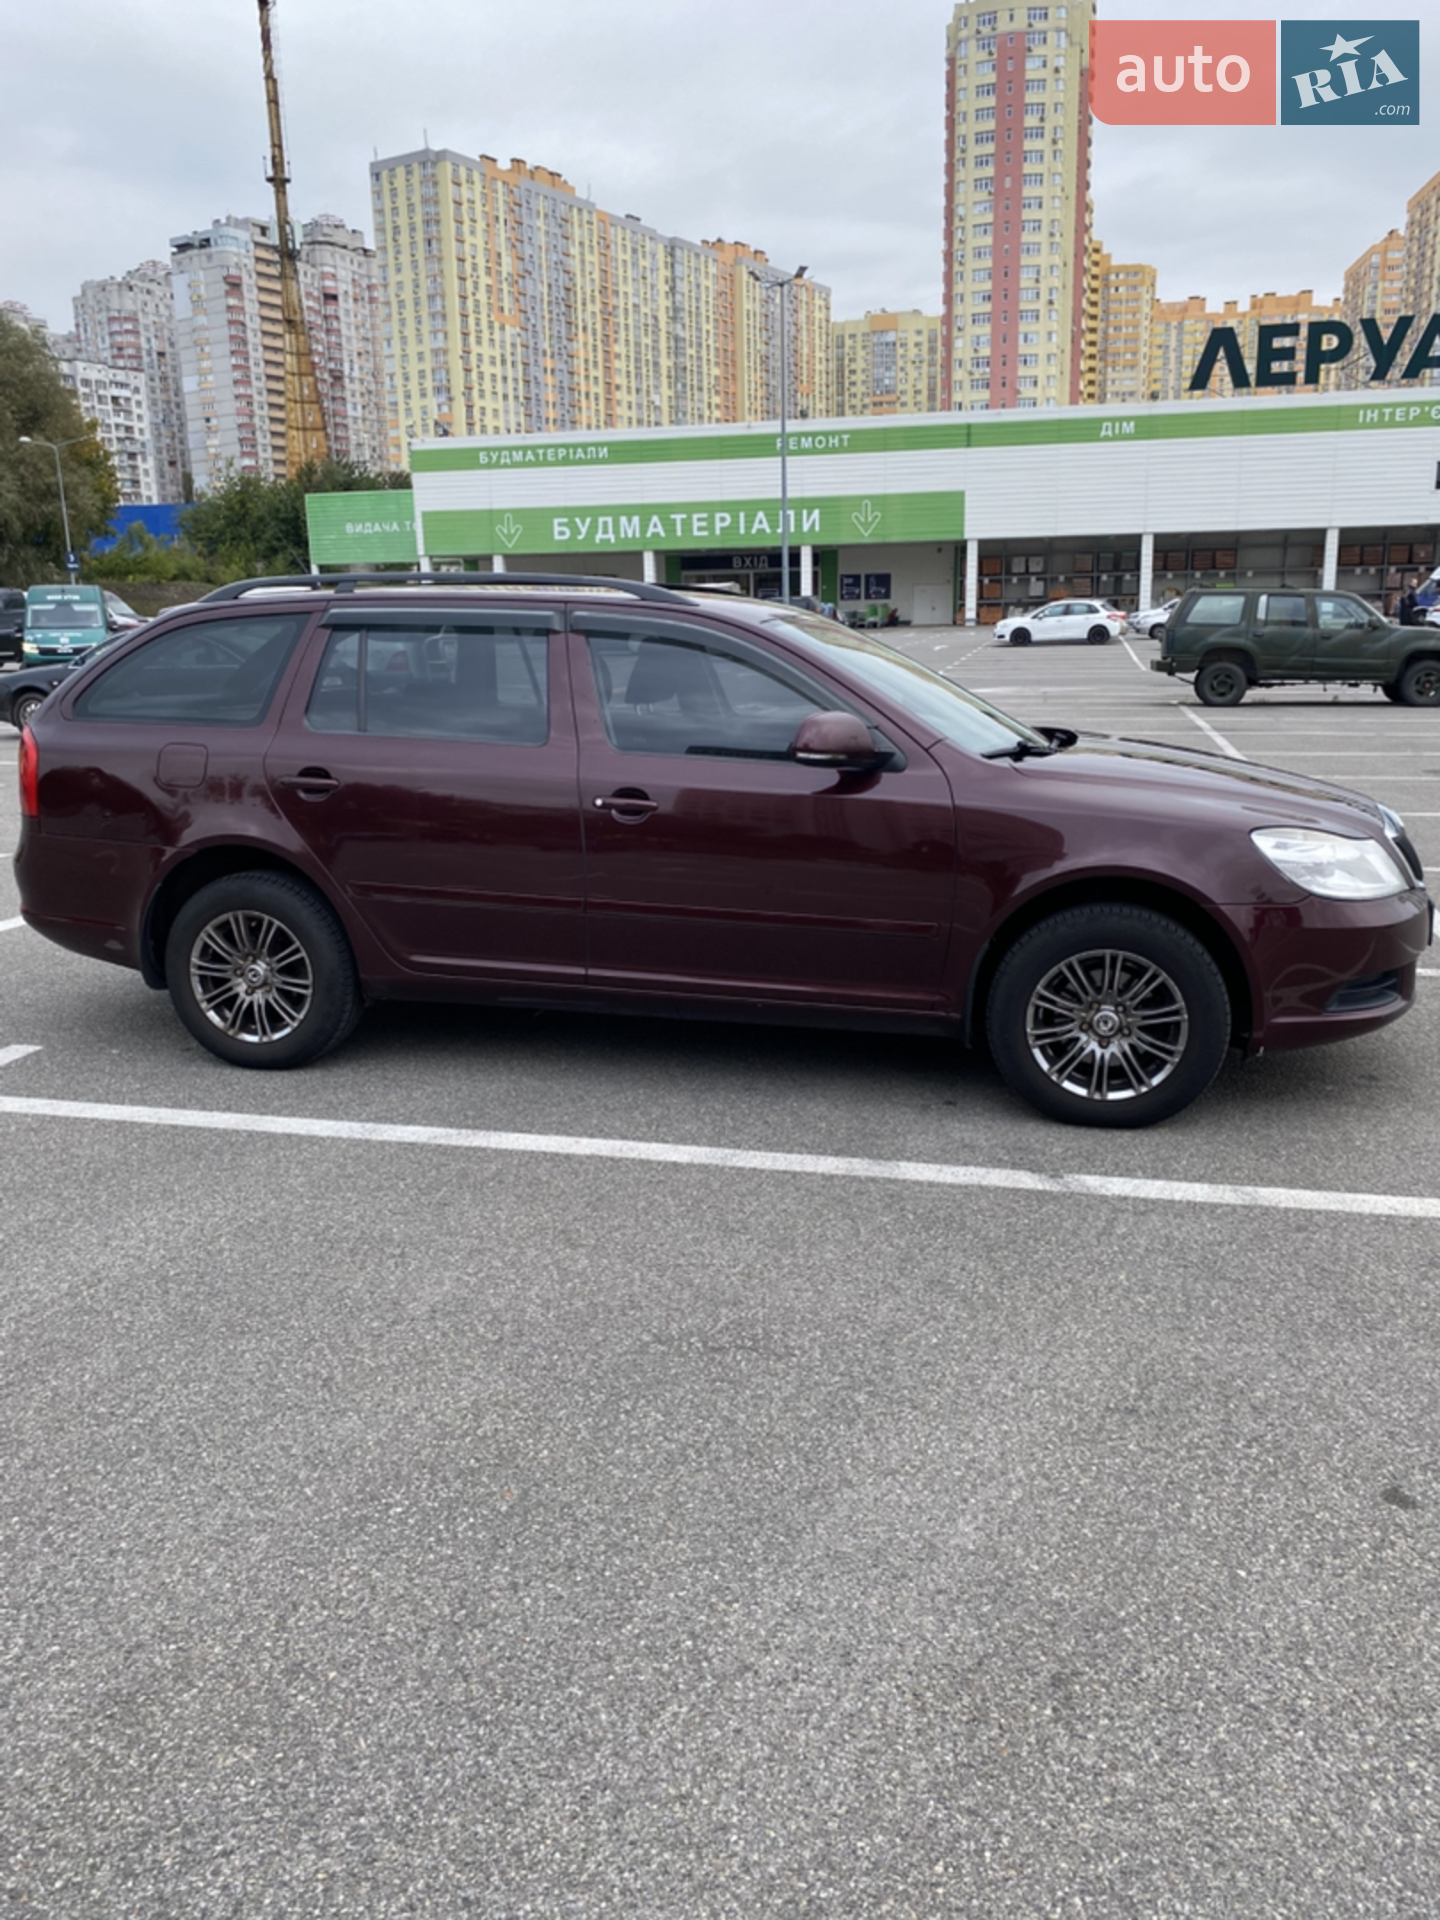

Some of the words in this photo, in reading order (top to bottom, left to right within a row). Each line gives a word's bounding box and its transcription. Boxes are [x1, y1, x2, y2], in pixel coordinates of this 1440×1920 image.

[1100, 421, 1135, 437] ДІМ
[479, 447, 609, 465] БУДМАТЕРІАЛИ
[345, 521, 399, 534] ВИДАЧА
[553, 508, 821, 543] БУДМАТЕРІАЛИ
[732, 555, 769, 569] ВХІД
